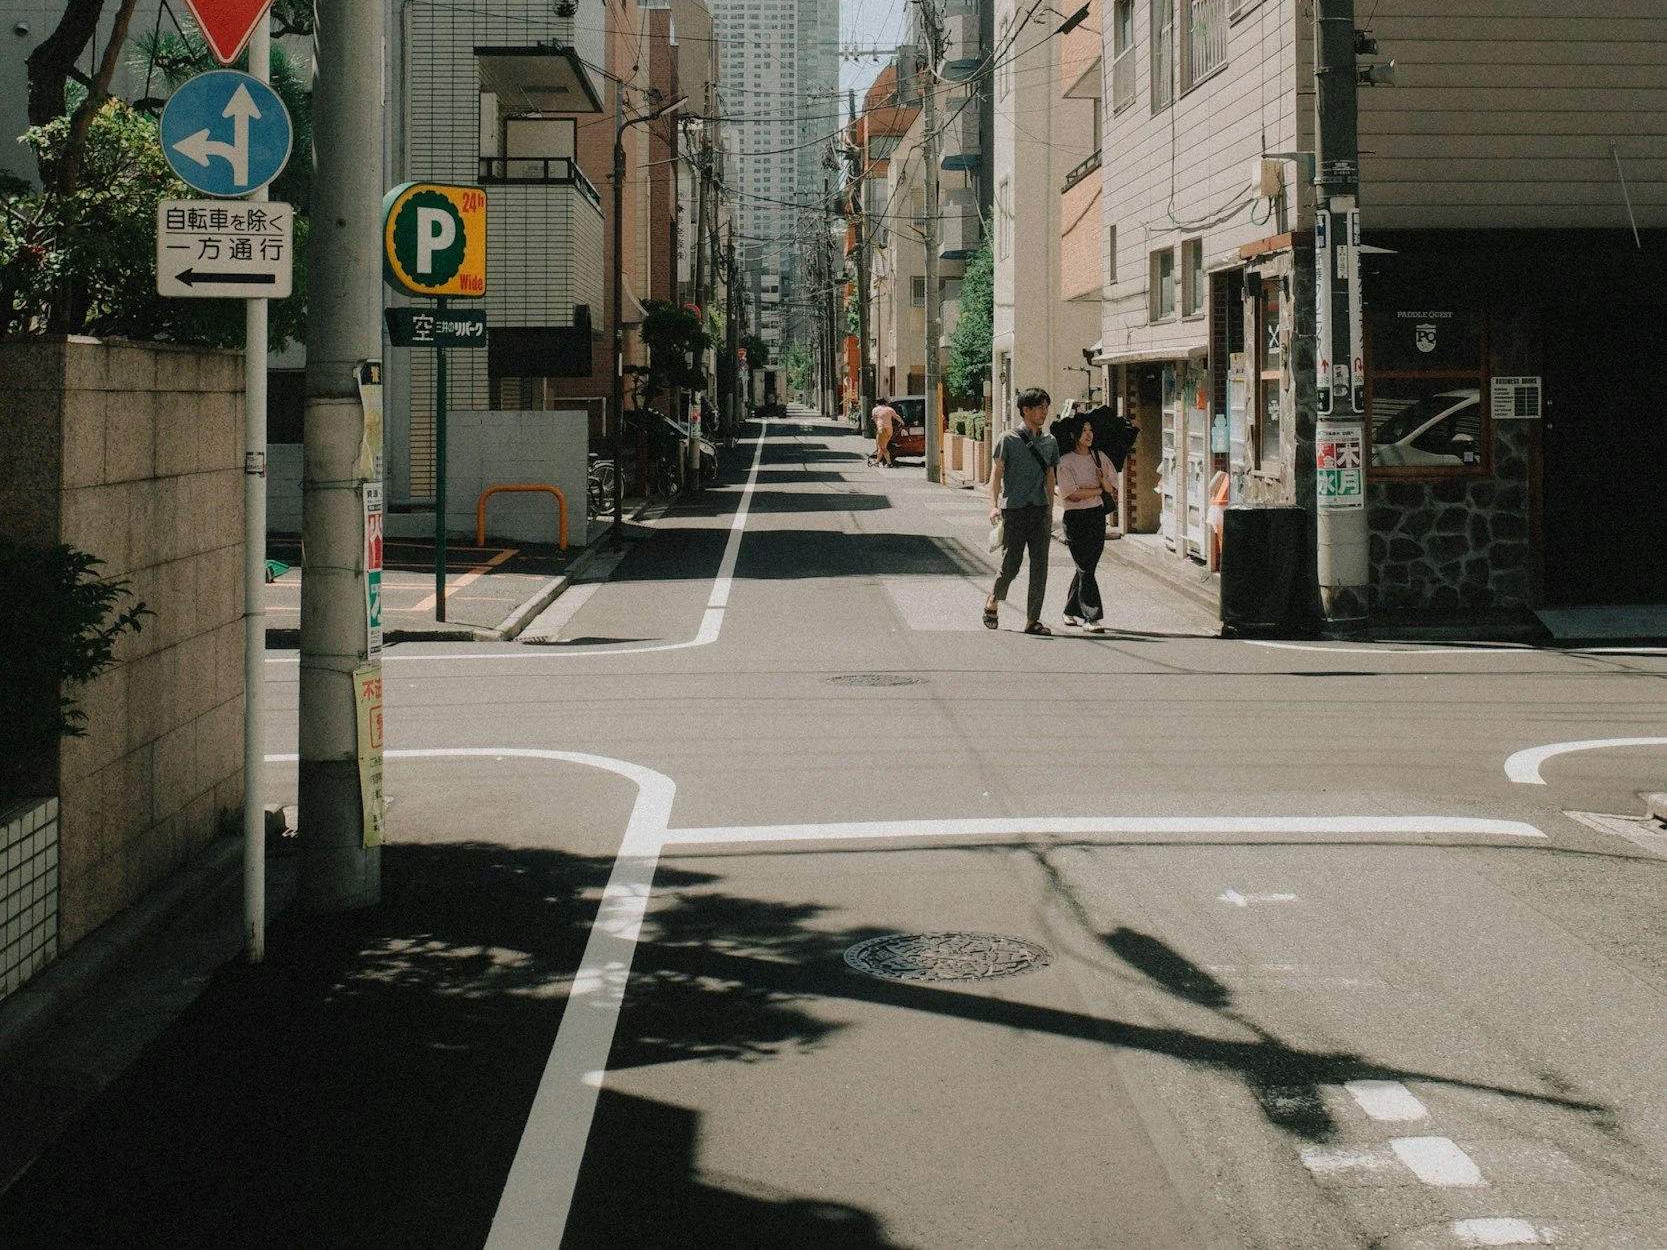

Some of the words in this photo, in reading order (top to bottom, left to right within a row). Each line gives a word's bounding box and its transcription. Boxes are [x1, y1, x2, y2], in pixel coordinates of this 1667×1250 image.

[462, 192, 484, 213] 24h
[166, 208, 283, 231] 自転車を除く
[166, 237, 283, 261] 一方通行
[416, 206, 456, 274] P
[460, 274, 483, 291] Wide
[1428, 310, 1453, 319] QUEST
[412, 314, 434, 341] 空
[436, 321, 483, 337] 三井のリパーク
[1338, 471, 1360, 495] 月
